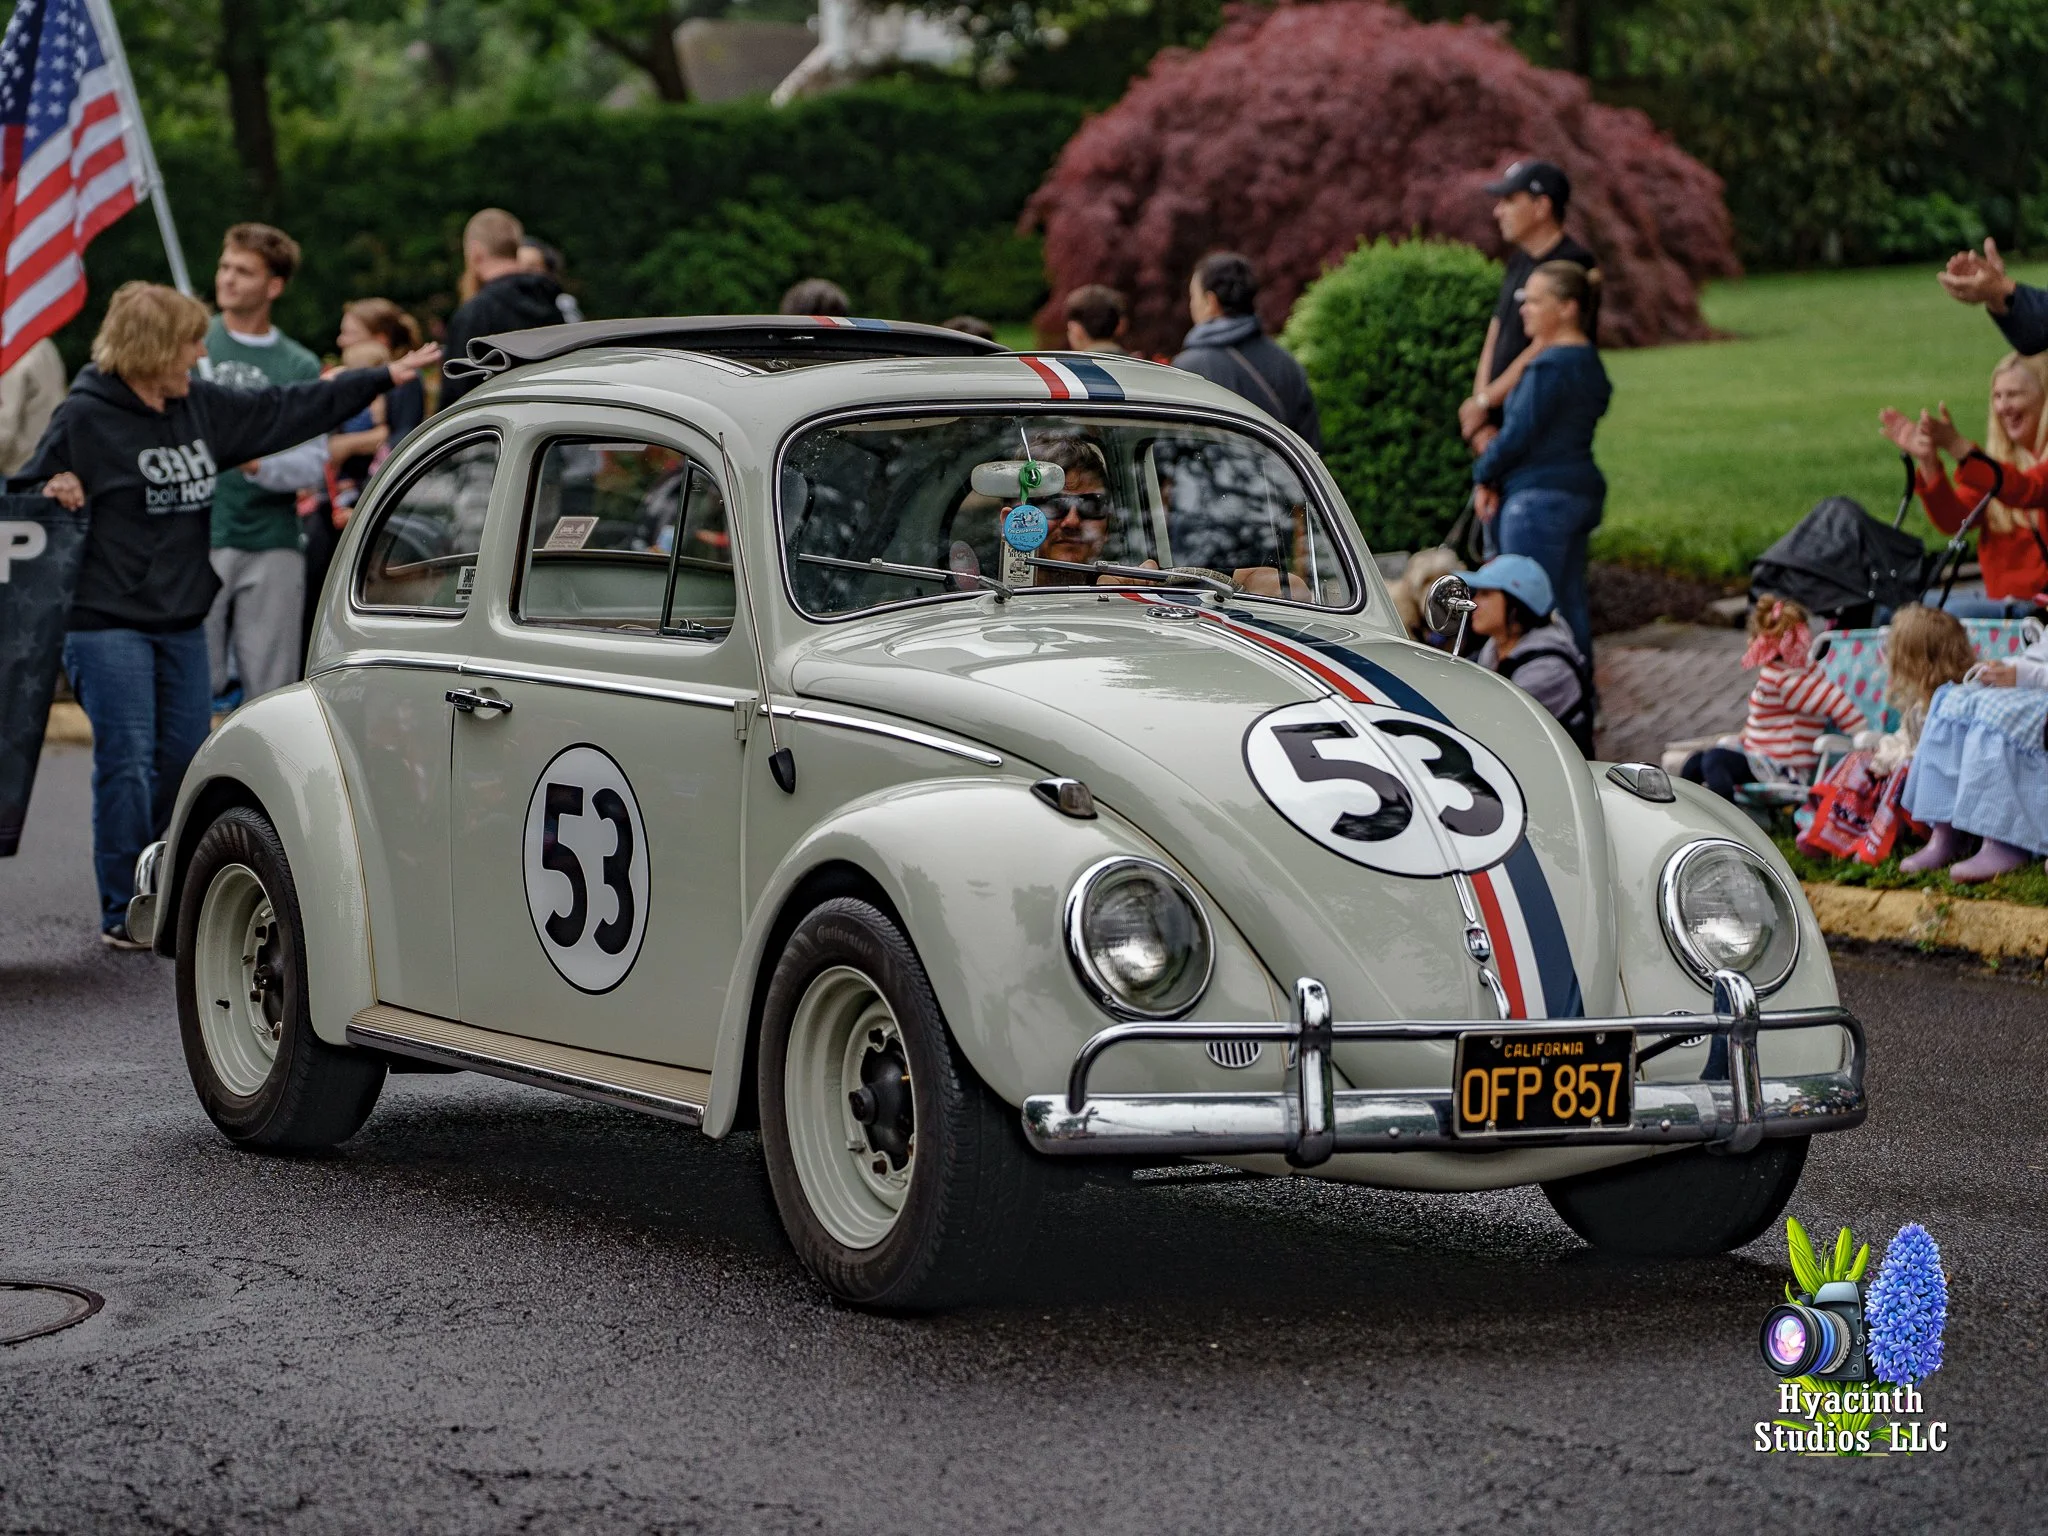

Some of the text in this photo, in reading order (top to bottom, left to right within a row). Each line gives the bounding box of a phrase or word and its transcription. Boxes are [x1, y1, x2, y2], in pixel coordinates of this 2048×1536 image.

[0, 520, 47, 584] P
[1270, 719, 1504, 842] 53
[542, 782, 635, 955] 53
[1504, 1041, 1584, 1058] CALIFORNIA
[1462, 1062, 1623, 1123] OFP 857
